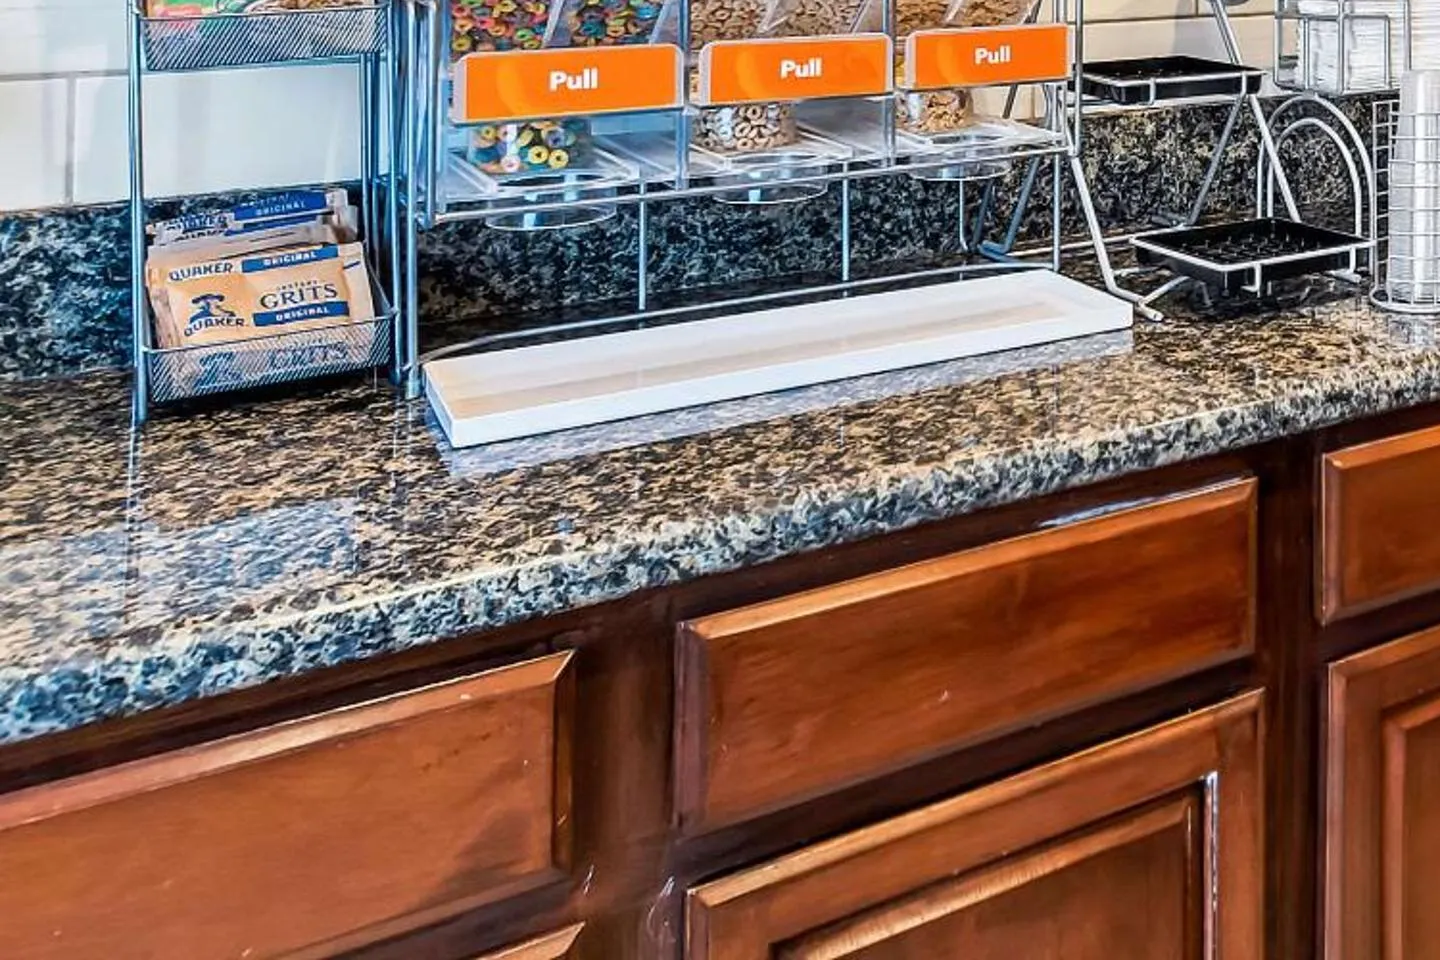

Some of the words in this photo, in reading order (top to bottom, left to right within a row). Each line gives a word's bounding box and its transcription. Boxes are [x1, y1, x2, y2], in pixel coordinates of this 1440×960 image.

[976, 46, 1010, 63] Pull
[781, 59, 821, 77] Pull
[550, 69, 597, 90] Pull
[168, 261, 234, 282] QUAKER
[263, 250, 317, 267] ORIGINAL
[259, 283, 339, 310] GRITS
[275, 306, 330, 322] ORIGINAL
[183, 316, 245, 337] QUAKER
